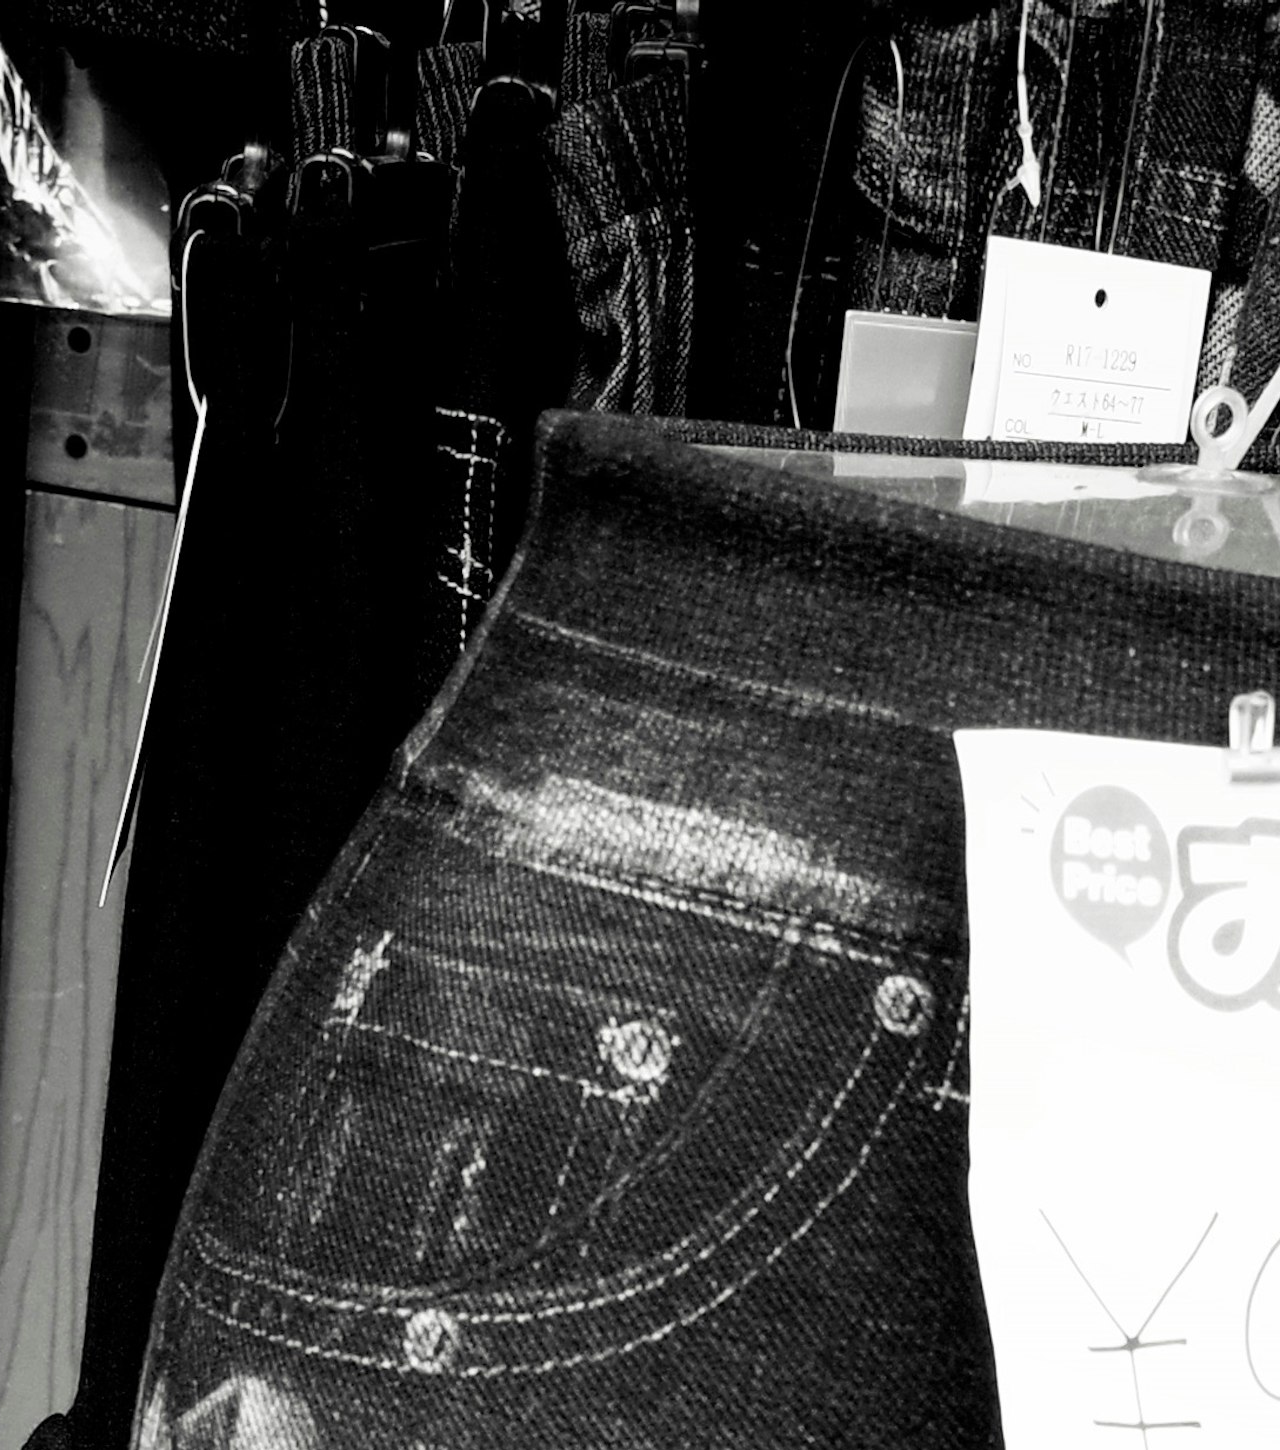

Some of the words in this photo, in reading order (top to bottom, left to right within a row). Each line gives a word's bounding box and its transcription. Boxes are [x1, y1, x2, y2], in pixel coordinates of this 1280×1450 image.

[1013, 353, 1032, 368] NO
[1004, 417, 1030, 435] COL
[1063, 816, 1152, 862] Best
[1062, 860, 1163, 907] Price
